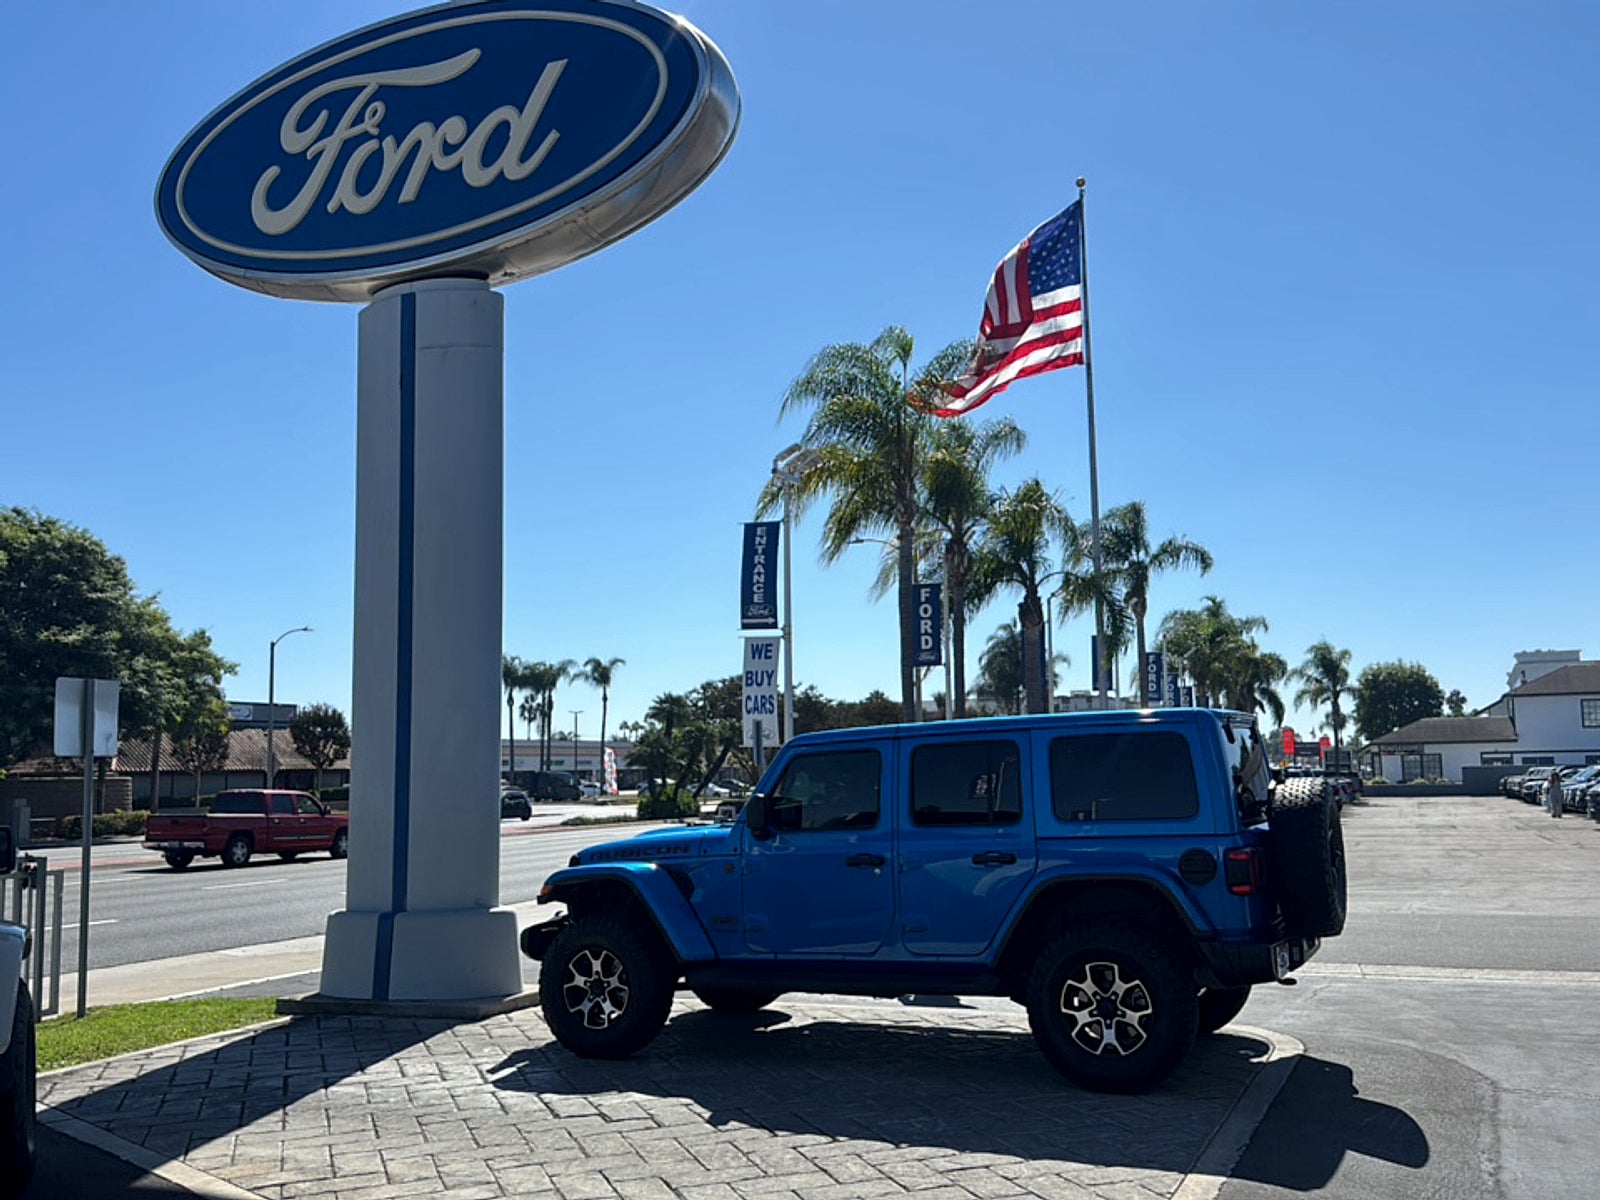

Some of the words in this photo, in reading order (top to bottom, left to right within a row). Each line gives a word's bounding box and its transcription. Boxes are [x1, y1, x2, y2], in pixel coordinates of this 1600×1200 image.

[251, 48, 568, 236] Ford
[752, 526, 767, 603] ENTRANCE
[919, 588, 933, 650] FORD
[751, 643, 773, 660] WE
[745, 670, 774, 687] BUY
[1147, 655, 1157, 691] FORD
[745, 695, 775, 715] CARS
[590, 844, 691, 861] RUBICON
